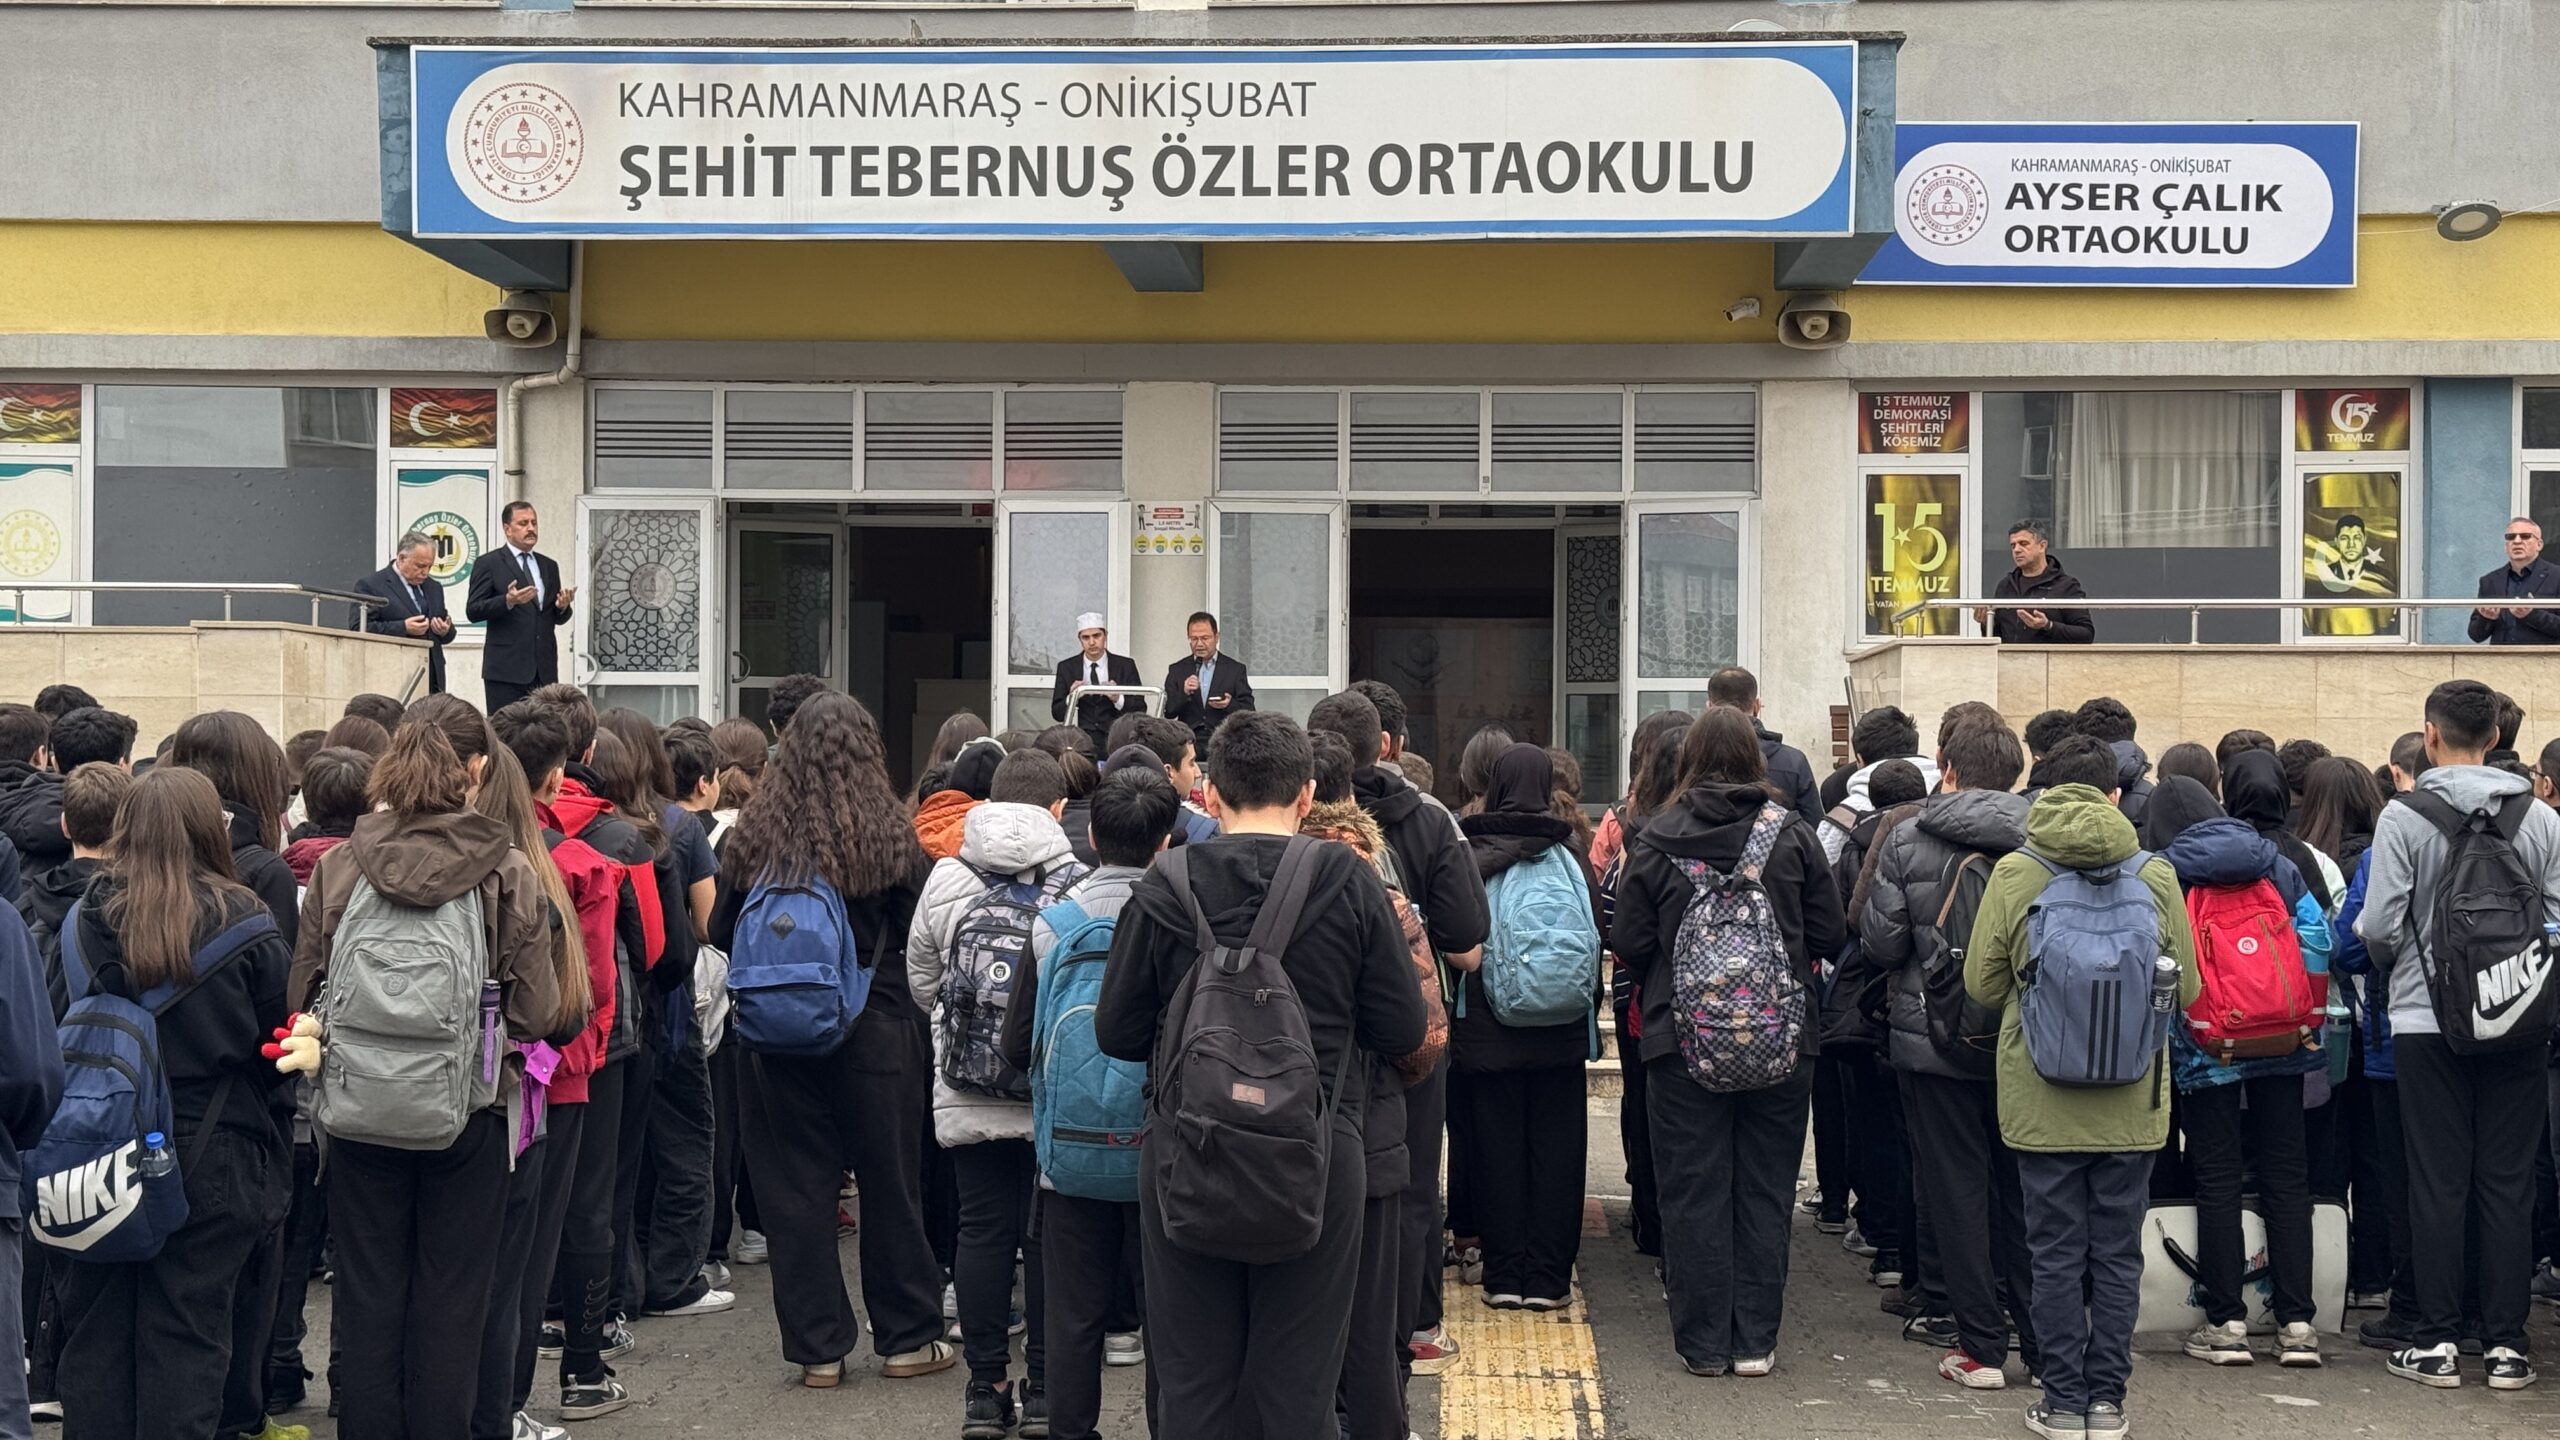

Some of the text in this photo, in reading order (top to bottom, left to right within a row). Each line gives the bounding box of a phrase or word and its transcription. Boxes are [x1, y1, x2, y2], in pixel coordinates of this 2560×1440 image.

[619, 82, 1022, 127] KAHRAMANMARAŞ
[1060, 75, 1317, 127] ONİKİŞUBAT
[619, 132, 1754, 212] ŞEHİT TEBERNUŞ ÖZLER ORTAOKULU
[2011, 158, 2139, 176] KAHRAMANMARAŞ
[2150, 157, 2232, 176] ONİKİŞUBAT
[2004, 182, 2140, 211] AYSER
[2152, 183, 2284, 219] ÇALIK
[2004, 224, 2250, 255] ORTAOKULU
[1875, 395, 1951, 407] 15 TEMMUZ
[1873, 407, 1952, 420] DEMOKRASİ
[1880, 421, 1945, 436] ŞEHİTLERİ
[2326, 433, 2375, 443] TEMMUZ
[1882, 434, 1942, 449] KÖŞEMİZ
[1874, 502, 1948, 572] 15
[1870, 576, 1951, 593] TEMMUZ
[1875, 600, 1900, 608] VATAN
[2476, 938, 2543, 1012] NIKE
[36, 1138, 141, 1228] NIKE
